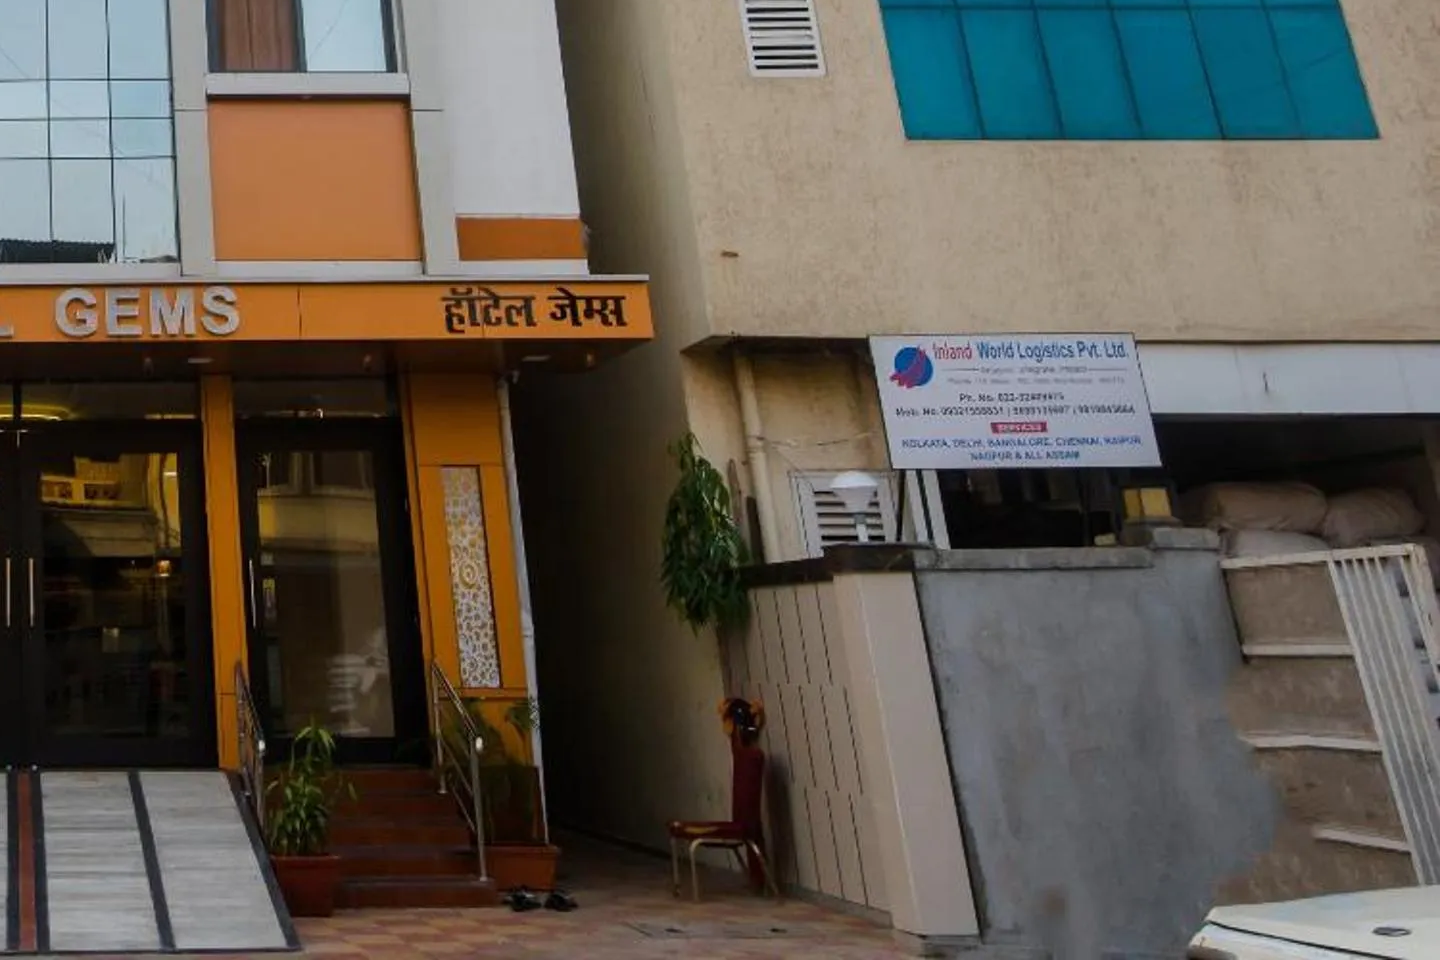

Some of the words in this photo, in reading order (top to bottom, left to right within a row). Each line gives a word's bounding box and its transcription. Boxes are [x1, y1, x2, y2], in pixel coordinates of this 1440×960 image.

[55, 286, 241, 337] GEMS
[547, 284, 628, 327] जेम्स
[932, 340, 973, 359] Inland
[976, 341, 1015, 359] World
[1017, 341, 1075, 363] Logistics
[1076, 340, 1102, 358] Pvt.
[1104, 340, 1129, 358] Ltd.
